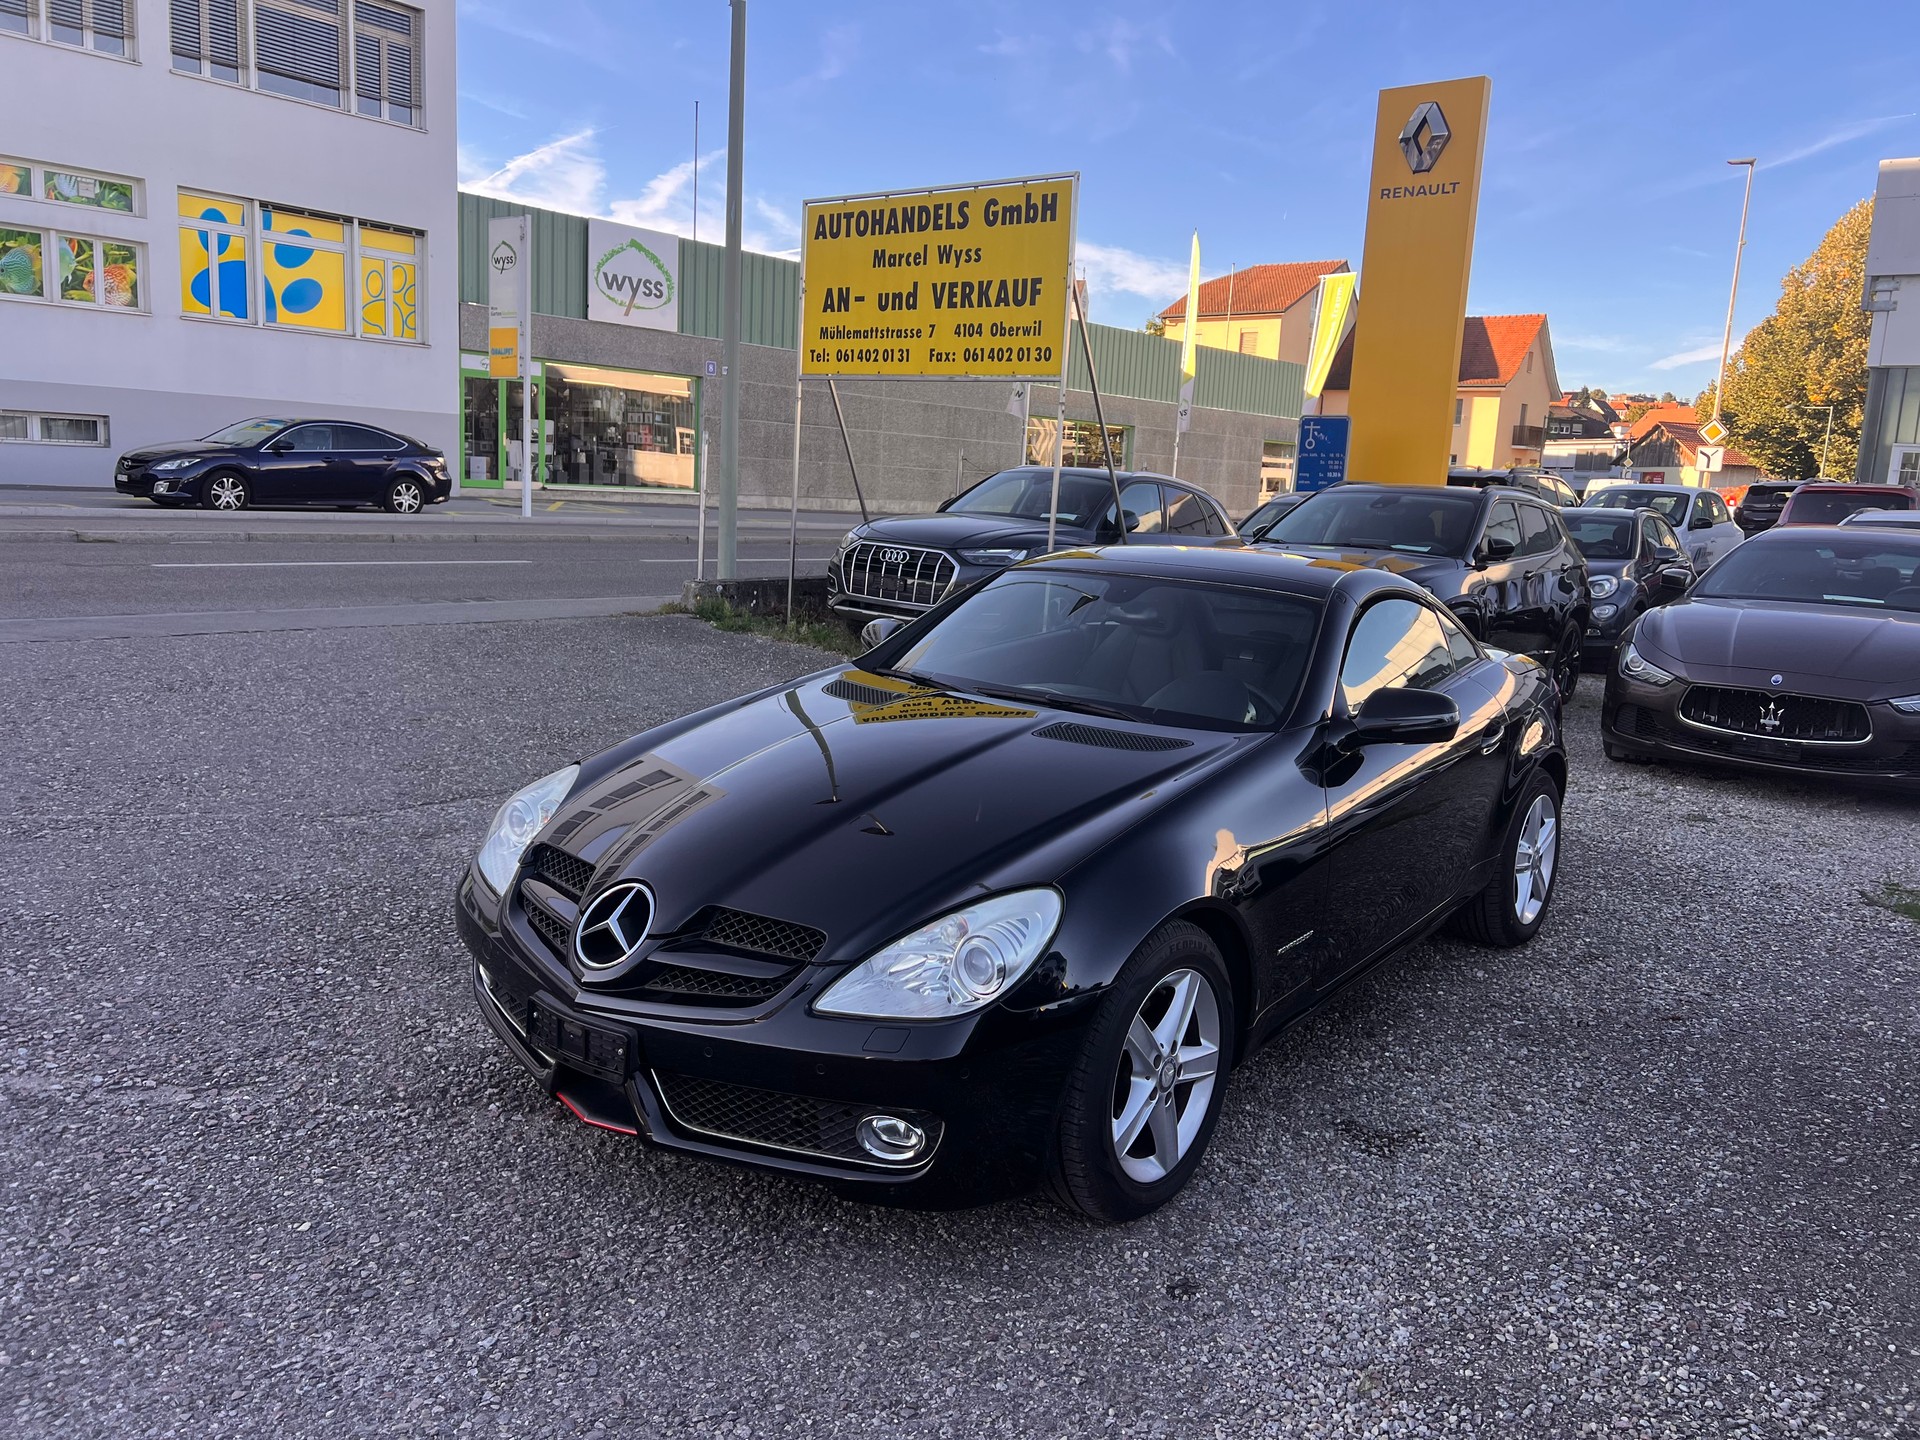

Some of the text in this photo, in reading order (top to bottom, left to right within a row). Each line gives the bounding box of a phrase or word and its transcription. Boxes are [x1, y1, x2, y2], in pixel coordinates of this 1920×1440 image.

[1380, 182, 1460, 200] RENAULT
[814, 192, 1059, 240] AUTOHANDELS GmbH
[493, 256, 514, 275] wyss
[872, 243, 982, 269] Marcel Wyss
[602, 271, 664, 317] wyss
[877, 281, 918, 312] und
[931, 277, 1043, 310] VERKAUF
[819, 320, 1042, 340] Mühlemattstrasse 7 4104 Oberwil
[810, 348, 830, 363] Tel:
[929, 348, 956, 363] Fax:
